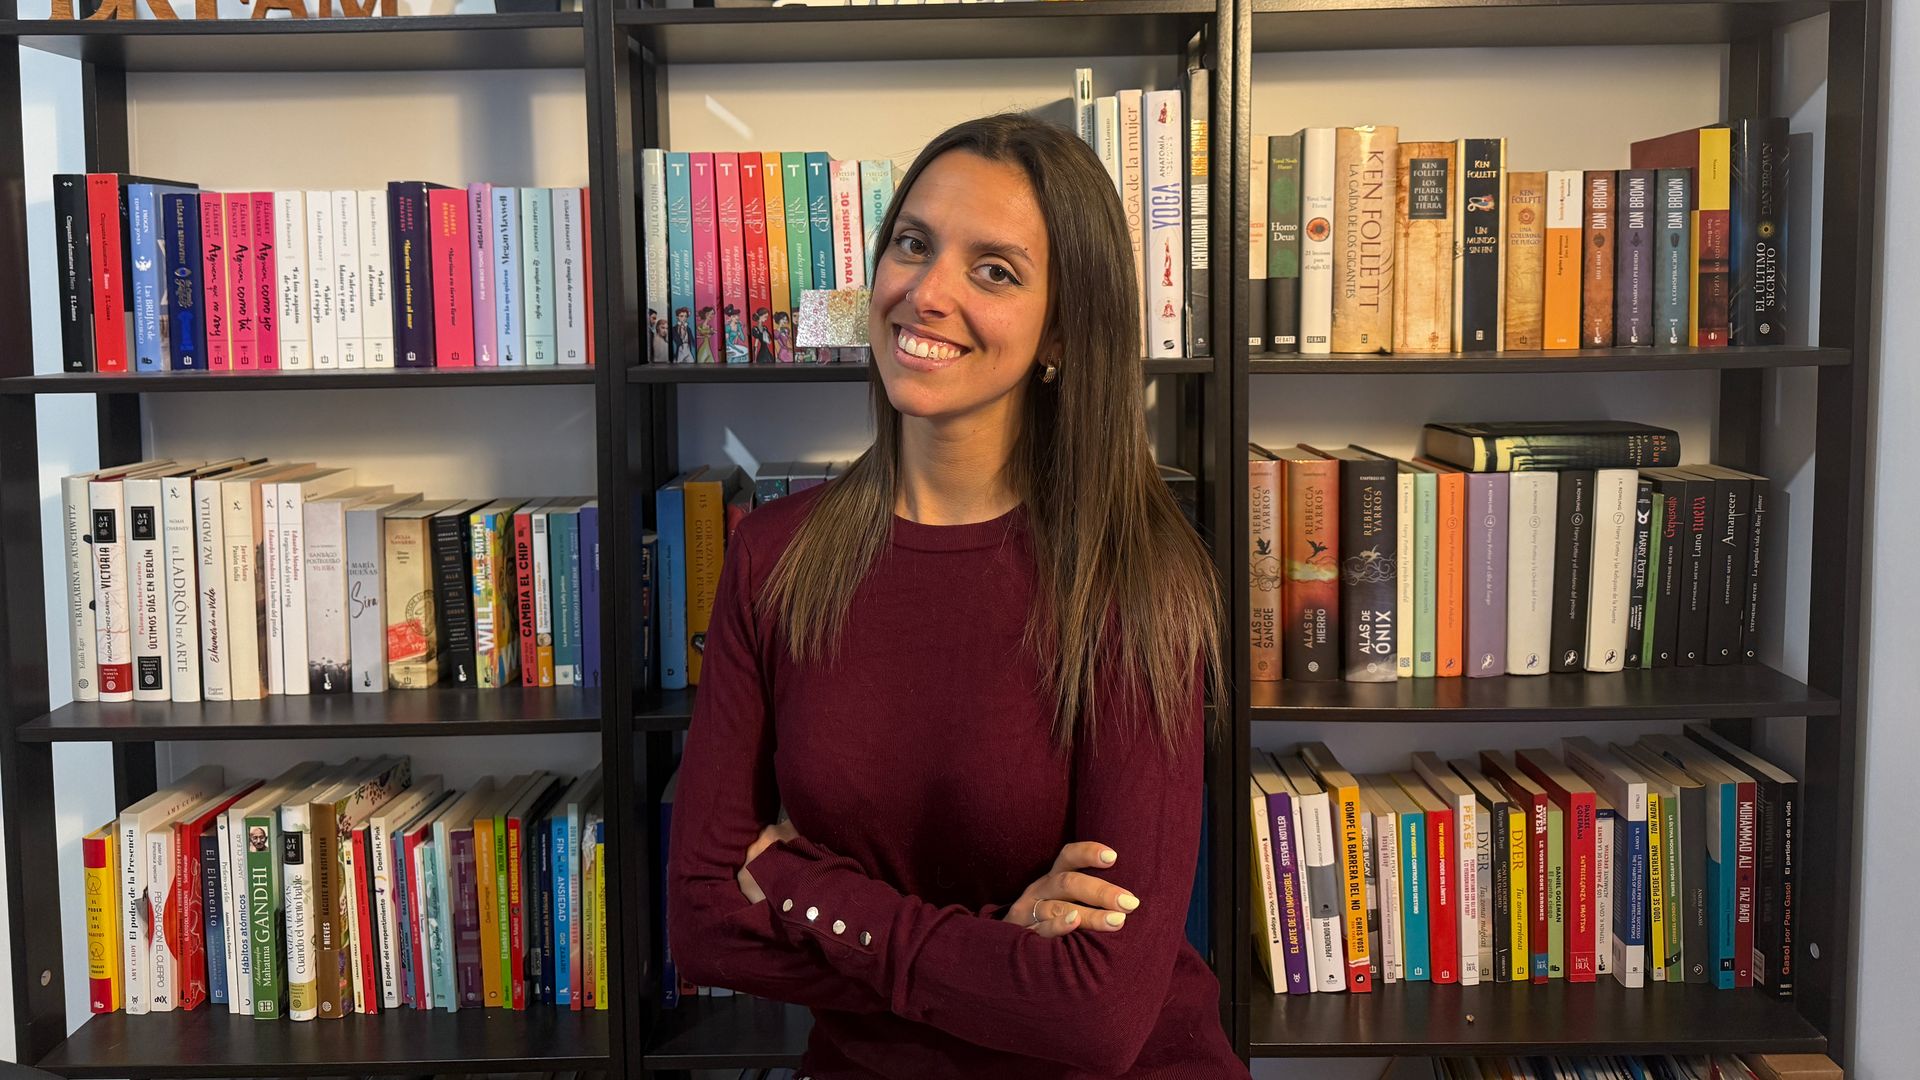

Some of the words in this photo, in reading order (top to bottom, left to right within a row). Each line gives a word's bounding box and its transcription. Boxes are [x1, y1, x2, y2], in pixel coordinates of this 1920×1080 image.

[1125, 107, 1139, 151] mujer
[1126, 157, 1138, 168] la
[1350, 164, 1359, 177] LA
[1362, 150, 1384, 199] KEN
[1413, 169, 1444, 177] FOLLETT
[1126, 175, 1138, 191] de
[1348, 180, 1360, 212] CAÍDA
[1630, 178, 1644, 208] BROWN
[1668, 178, 1683, 208] BROWN
[650, 184, 658, 212] QUINN
[841, 192, 849, 206] 30
[1152, 183, 1180, 230] YOGA
[1191, 184, 1208, 215] MAMBA
[1415, 202, 1441, 210] TIERRA
[500, 196, 508, 232] Maxwell
[651, 214, 659, 237] JULIA
[1127, 195, 1140, 232] YOGA
[1271, 223, 1297, 231] Homo
[1348, 215, 1357, 227] DE
[1630, 212, 1644, 228] DAN
[1668, 213, 1682, 229] DAN
[842, 209, 851, 254] SUNSETS
[1191, 219, 1208, 269] MENTALIDAD
[1274, 232, 1295, 241] Deus
[1348, 230, 1356, 247] LOS
[404, 239, 412, 268] Martina
[501, 234, 510, 264] Megan
[1359, 210, 1382, 313] FOLLETT
[845, 256, 853, 283] PARA
[1346, 250, 1356, 298] GIGANTES
[1753, 243, 1766, 293] ÚLTIMO
[1766, 248, 1776, 306] SECRETO
[261, 284, 271, 314] como
[1756, 297, 1765, 312] EL
[209, 315, 221, 336] soy
[259, 317, 271, 331] yo
[201, 498, 211, 543] PADILLA
[1364, 487, 1372, 536] REBECCA
[1374, 490, 1382, 532] YARROS
[1721, 492, 1746, 547] Amanecer
[69, 505, 79, 558] AUSCHWITZ
[474, 523, 484, 559] SMITH
[1637, 531, 1647, 557] HARRY
[1692, 534, 1702, 557] Luna
[172, 546, 179, 554] EL
[204, 547, 212, 565] PAZ
[519, 542, 529, 569] CHIP
[695, 520, 703, 573] CORNELIA
[100, 547, 110, 589] VICTORIA
[144, 549, 155, 578] BERLÍN
[476, 562, 485, 590] WILL
[1636, 560, 1645, 588] POTTER
[147, 582, 155, 591] EN
[172, 557, 189, 625] LADRÓN
[521, 573, 529, 586] EL
[74, 571, 83, 618] BAILARINA
[146, 594, 156, 612] DÍAS
[351, 580, 378, 619] Sira
[696, 578, 704, 611] FUNKE
[477, 601, 494, 651] WILL
[522, 591, 531, 637] CAMBIA
[1254, 608, 1261, 617] DE
[1305, 609, 1312, 620] DE
[1317, 609, 1326, 643] HIERRO
[1361, 611, 1370, 620] DE
[148, 614, 158, 649] ÚLTIMOS
[176, 628, 182, 639] DE
[1252, 621, 1262, 648] ALAS
[1264, 608, 1273, 648] SANGRE
[1304, 623, 1313, 648] ALAS
[1359, 624, 1370, 654] ALAS
[1374, 610, 1391, 654] ÓNIX
[176, 640, 187, 672] ARTE
[1278, 816, 1288, 840] KOTLER
[1344, 801, 1356, 830] ROMPE
[1650, 820, 1658, 834] TONI
[1739, 802, 1753, 852] MUHAMMAD
[1786, 819, 1791, 827] mi
[1347, 832, 1356, 842] LA
[1786, 829, 1791, 837] de
[126, 829, 135, 874] Presencia
[206, 849, 215, 861] El
[1280, 842, 1290, 865] STEVEN
[1348, 844, 1358, 880] BARRERA
[1512, 830, 1523, 870] DYER
[1739, 855, 1752, 868] ALI
[127, 876, 135, 885] la
[128, 887, 136, 898] de
[1283, 873, 1295, 907] IMPOSIBLE
[1350, 883, 1359, 897] DEL
[1739, 887, 1750, 901] FIAZ
[208, 868, 218, 926] Elemento
[253, 867, 270, 942] GANDHI
[557, 876, 566, 921] ANSIEDAD
[1351, 900, 1360, 911] NO
[128, 900, 138, 928] poder
[238, 894, 248, 937] atómicos
[379, 899, 390, 949] arrepentimiento
[1287, 909, 1296, 917] LO
[1288, 919, 1297, 927] DE
[1738, 904, 1750, 923] RAFIQ
[129, 930, 137, 940] El
[1289, 928, 1298, 944] ARTE
[1517, 923, 1525, 950] erróneas
[240, 939, 250, 974] Hábitos
[262, 946, 271, 986] Mahatma
[382, 951, 390, 960] del
[1782, 946, 1791, 974] Gasol
[384, 962, 392, 979] poder
